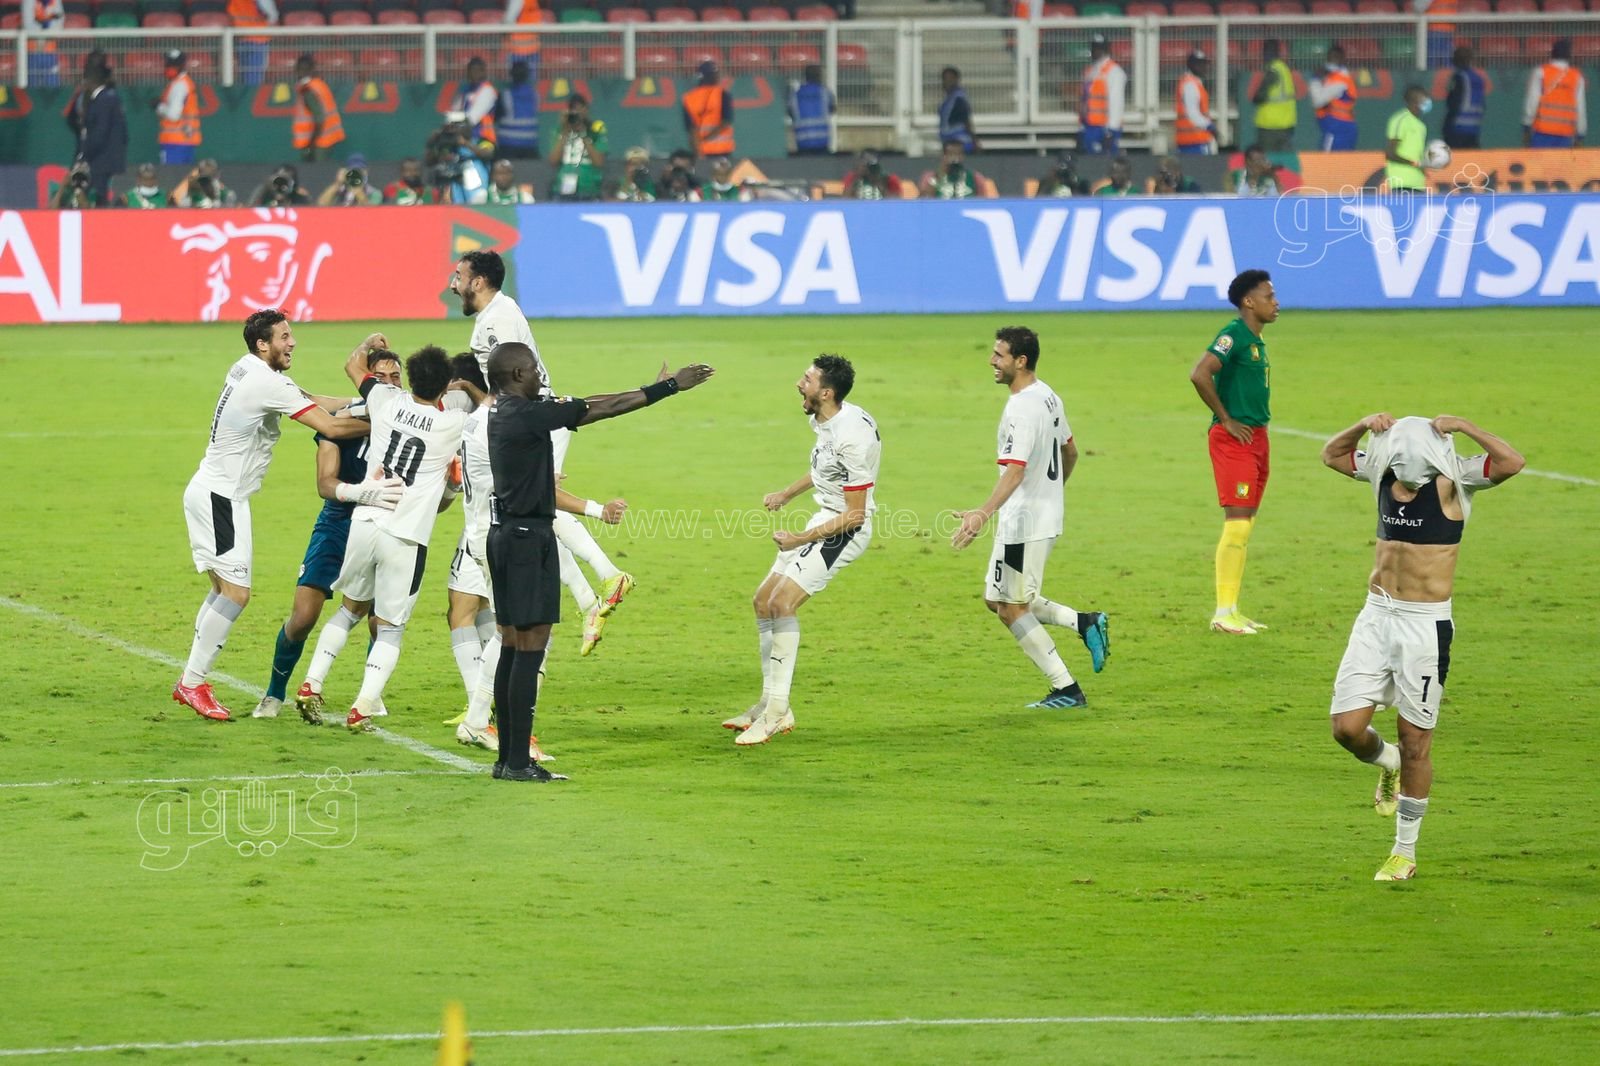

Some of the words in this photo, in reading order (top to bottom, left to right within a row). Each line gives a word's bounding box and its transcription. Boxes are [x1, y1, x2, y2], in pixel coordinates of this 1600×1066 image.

[0, 210, 122, 322] AL
[579, 210, 862, 307] VISA
[961, 206, 1238, 302] VISA
[1340, 202, 1600, 298] VISA
[382, 429, 427, 487] 10
[394, 408, 434, 432] M.SALAH
[1382, 514, 1424, 528] CATAPULT
[1420, 675, 1433, 703] 7
